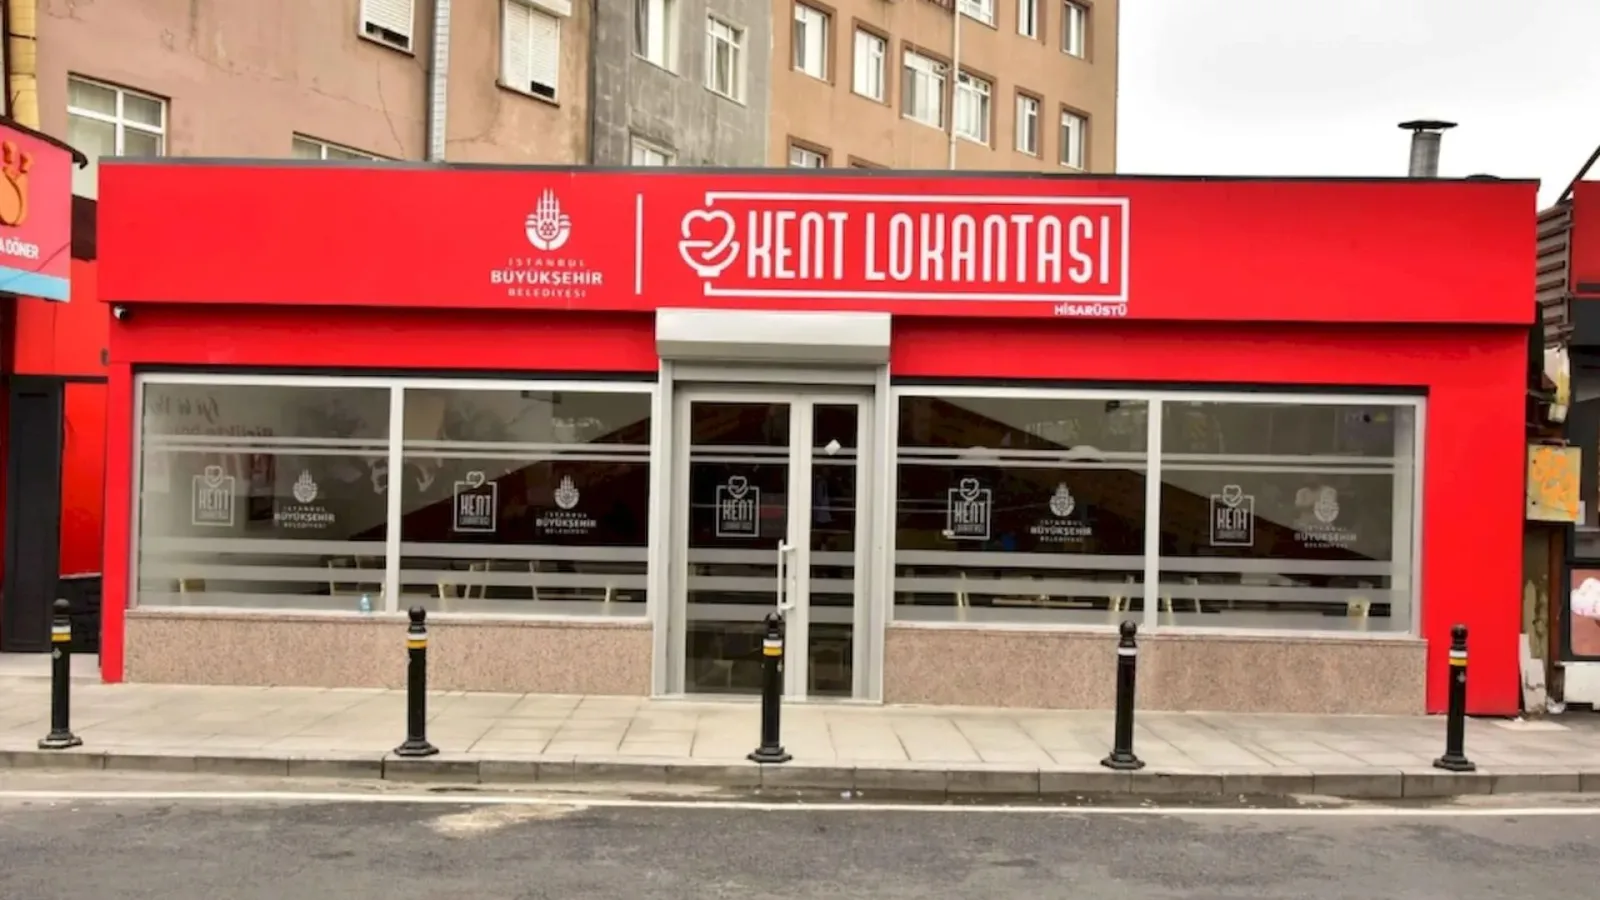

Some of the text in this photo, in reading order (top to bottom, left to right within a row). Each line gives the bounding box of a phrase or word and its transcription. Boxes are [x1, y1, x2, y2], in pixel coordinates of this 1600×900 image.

[6, 236, 40, 260] DÖNER
[746, 209, 1110, 285] KENT LOKANTASI
[490, 267, 604, 287] BÜYÜKŞEHİR
[1054, 302, 1128, 317] HİSARÜSTÜ
[199, 488, 229, 510] KENT
[460, 494, 491, 516] KENT
[722, 499, 754, 521] KENT
[954, 501, 986, 524] KENT
[1216, 508, 1247, 530] KENT
